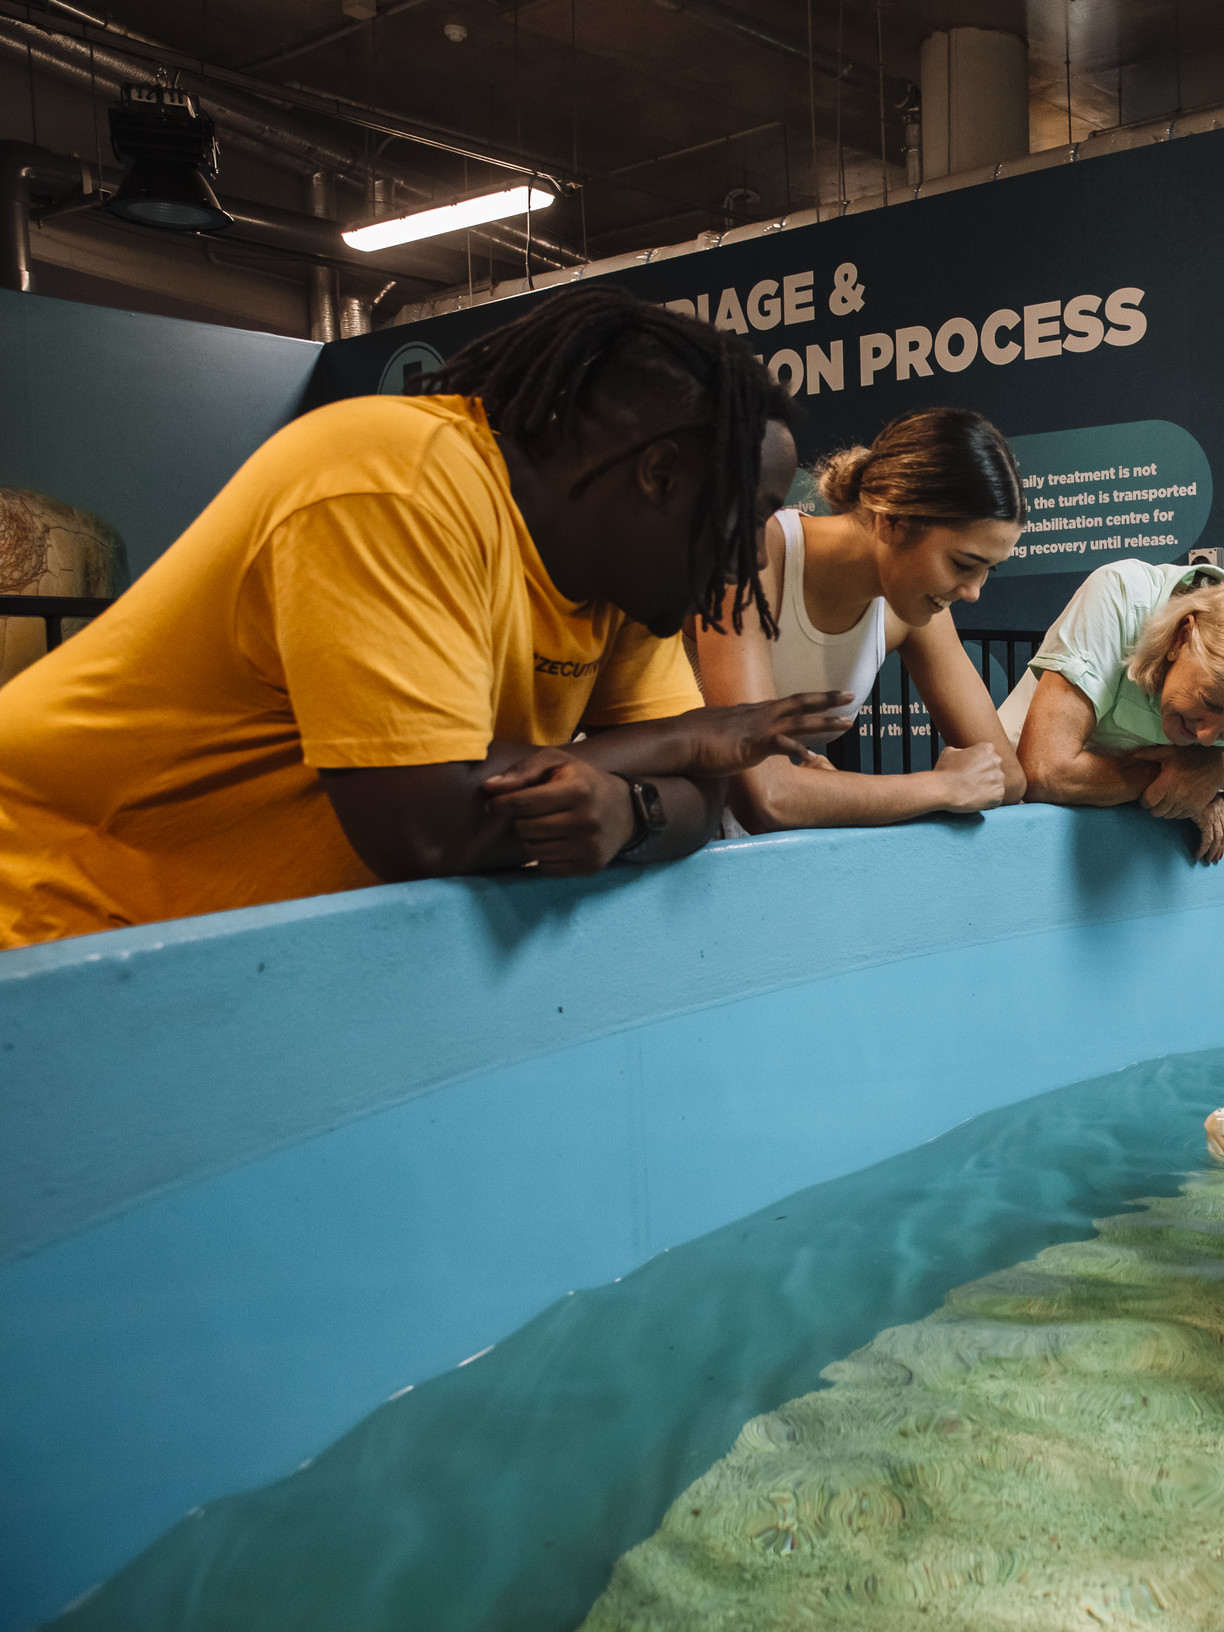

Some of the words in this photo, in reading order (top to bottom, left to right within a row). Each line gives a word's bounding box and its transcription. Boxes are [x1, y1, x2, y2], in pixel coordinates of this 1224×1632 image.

[656, 270, 815, 335] IAGE
[829, 262, 866, 316] &
[753, 339, 845, 397] ON
[859, 287, 1148, 387] PROCESS
[1022, 475, 1045, 488] aily
[1048, 467, 1116, 486] treatment
[1119, 465, 1130, 478] is
[1133, 463, 1157, 477] not
[1034, 496, 1055, 510] the
[1058, 492, 1096, 508] turtle
[1098, 491, 1110, 503] is
[1113, 482, 1197, 503] transported
[1021, 517, 1102, 533] ehabilitation
[1106, 512, 1150, 526] centre
[1153, 509, 1175, 523] for
[1009, 544, 1027, 558] ng
[1030, 541, 1087, 556] recovery
[1090, 535, 1121, 550] until
[1124, 533, 1179, 548] release.
